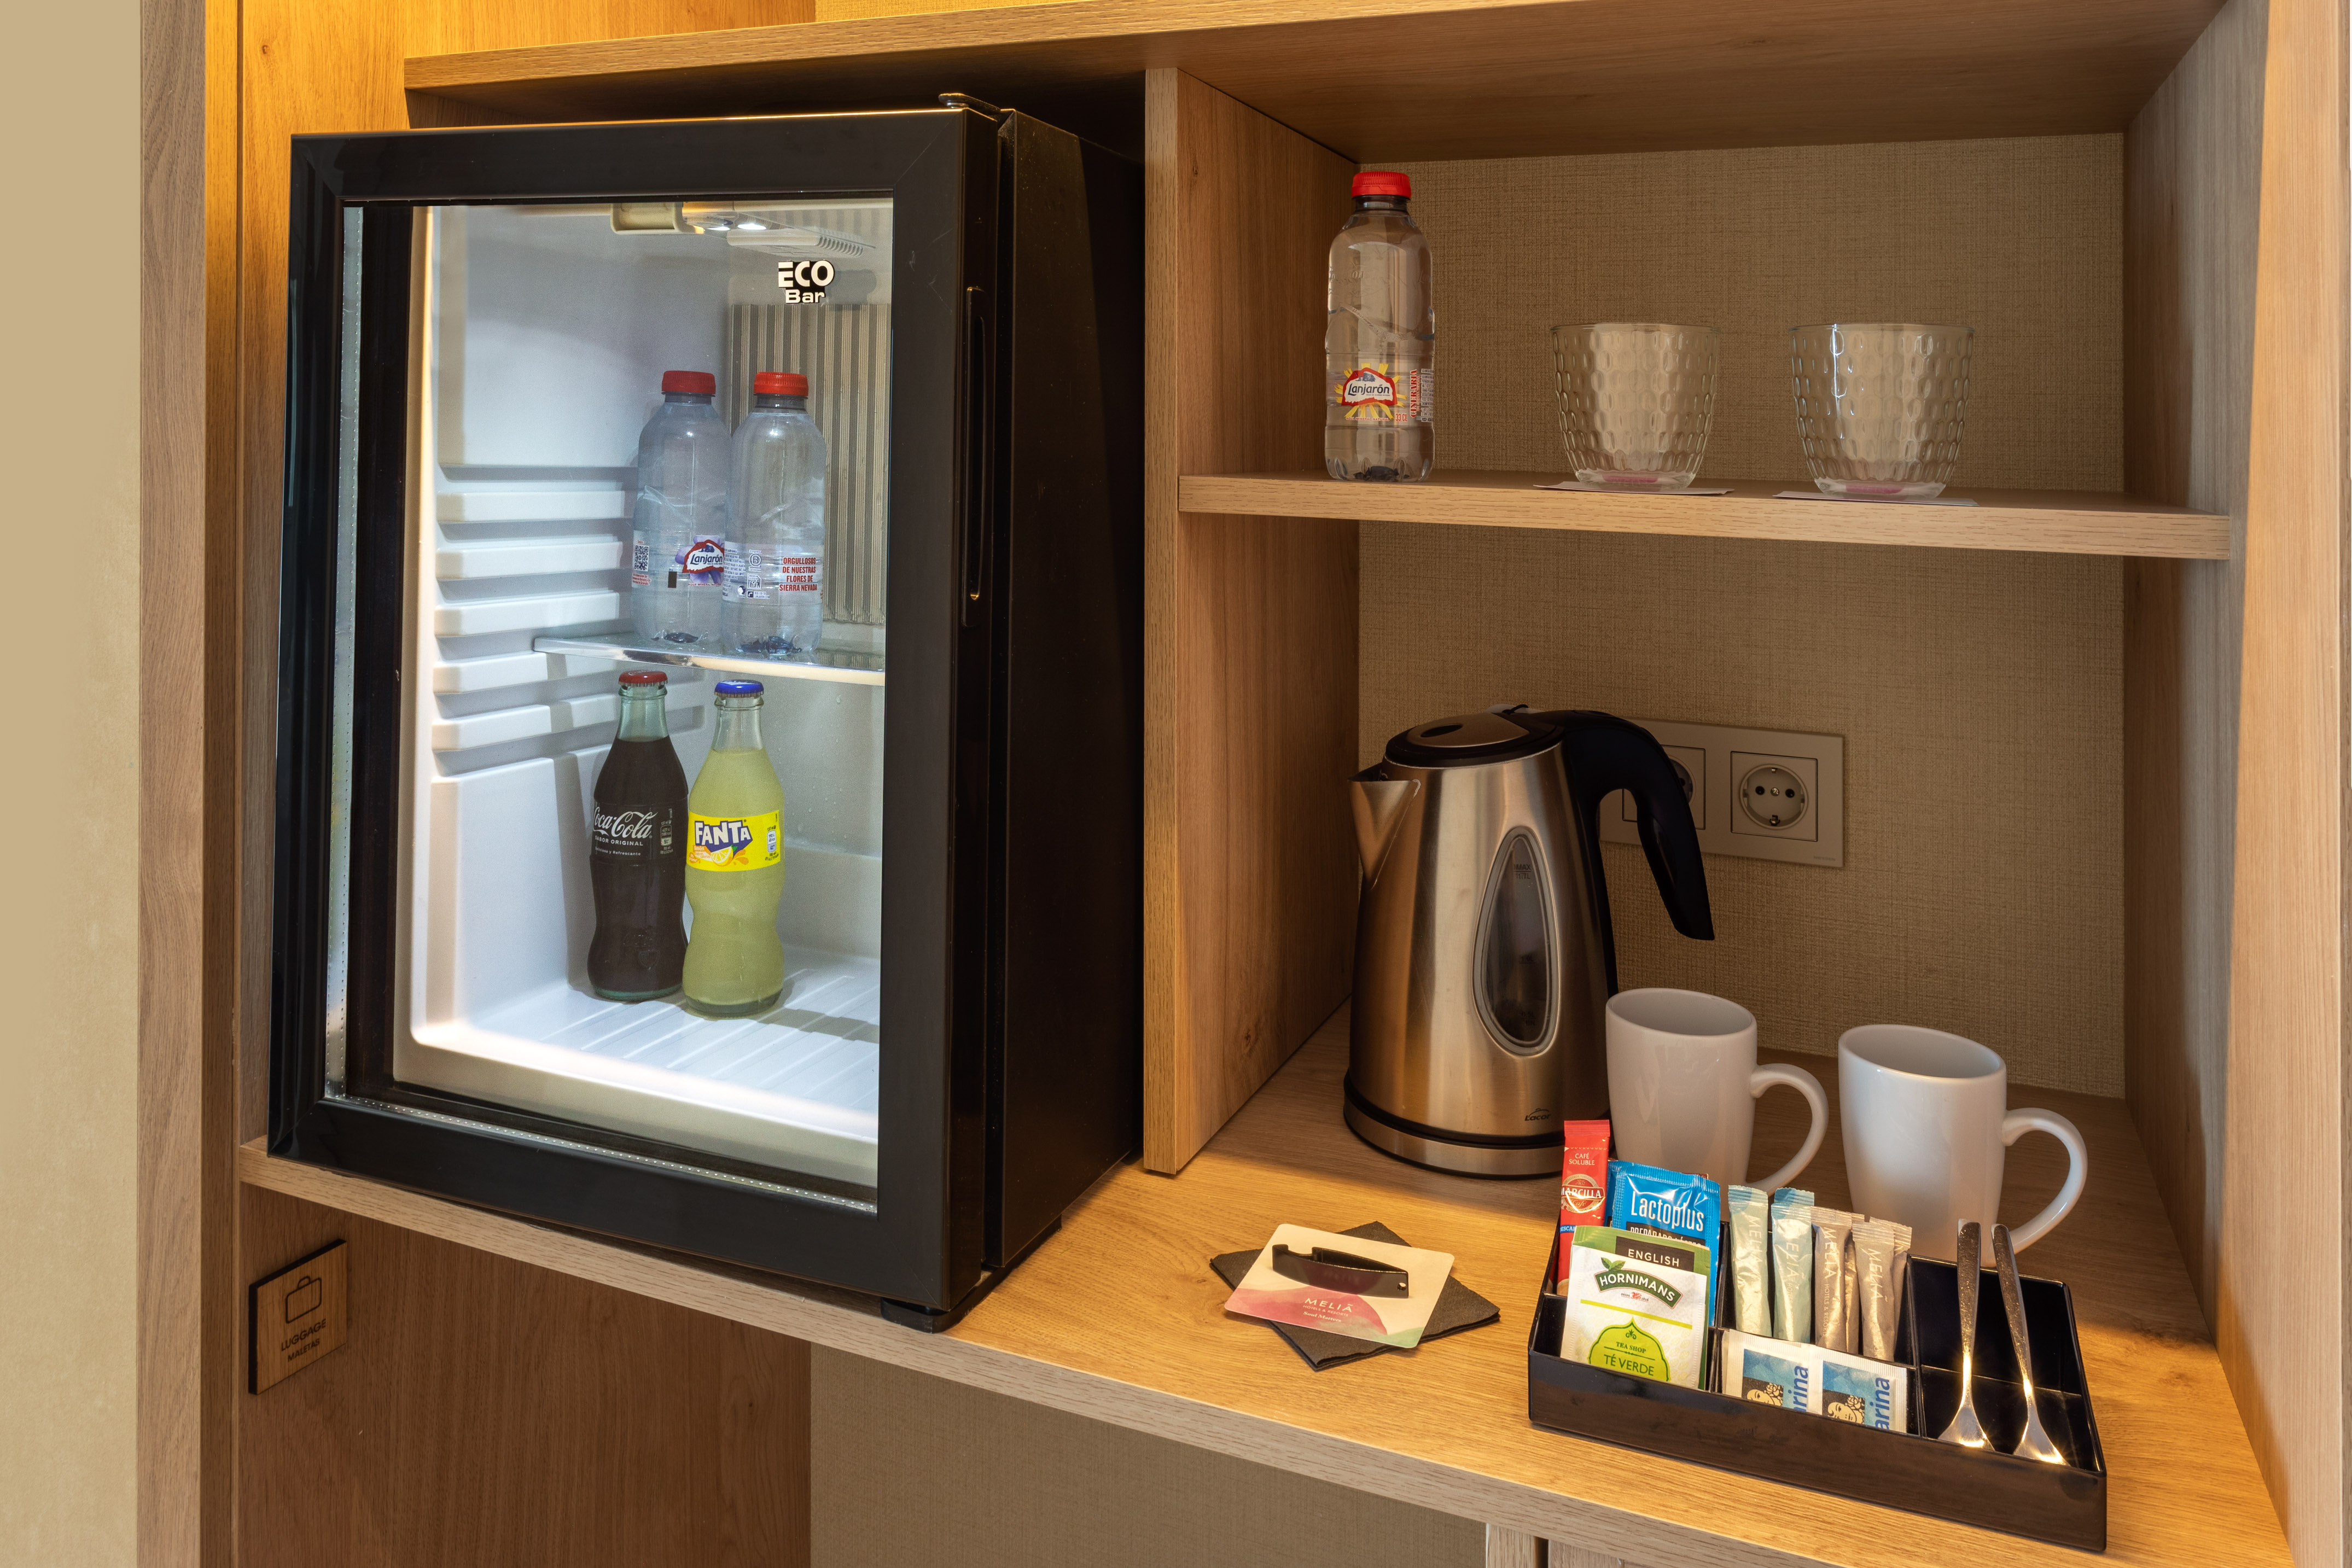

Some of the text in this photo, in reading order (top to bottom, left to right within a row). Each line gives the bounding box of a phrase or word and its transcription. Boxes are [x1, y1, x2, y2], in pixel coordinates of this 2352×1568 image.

[778, 260, 834, 287] ECO
[785, 289, 825, 303] Bar
[1348, 383, 1390, 396] Lanjarón
[1402, 413, 1407, 422] CL
[690, 553, 723, 566] Lanjarón
[593, 807, 658, 838] Coca-Cola
[695, 821, 752, 846] FANTA
[1561, 1187, 1602, 1198] MARCILLA
[1631, 1191, 1704, 1232] Lactoplus
[1628, 1249, 1679, 1267] ENGLISH
[1599, 1273, 1675, 1302] HORNIMANS
[281, 1318, 326, 1351] LUGGAGE
[288, 1338, 320, 1362] MALETAS
[1629, 1345, 1646, 1354] SHOP
[1604, 1354, 1654, 1376] TÉ VERDE
